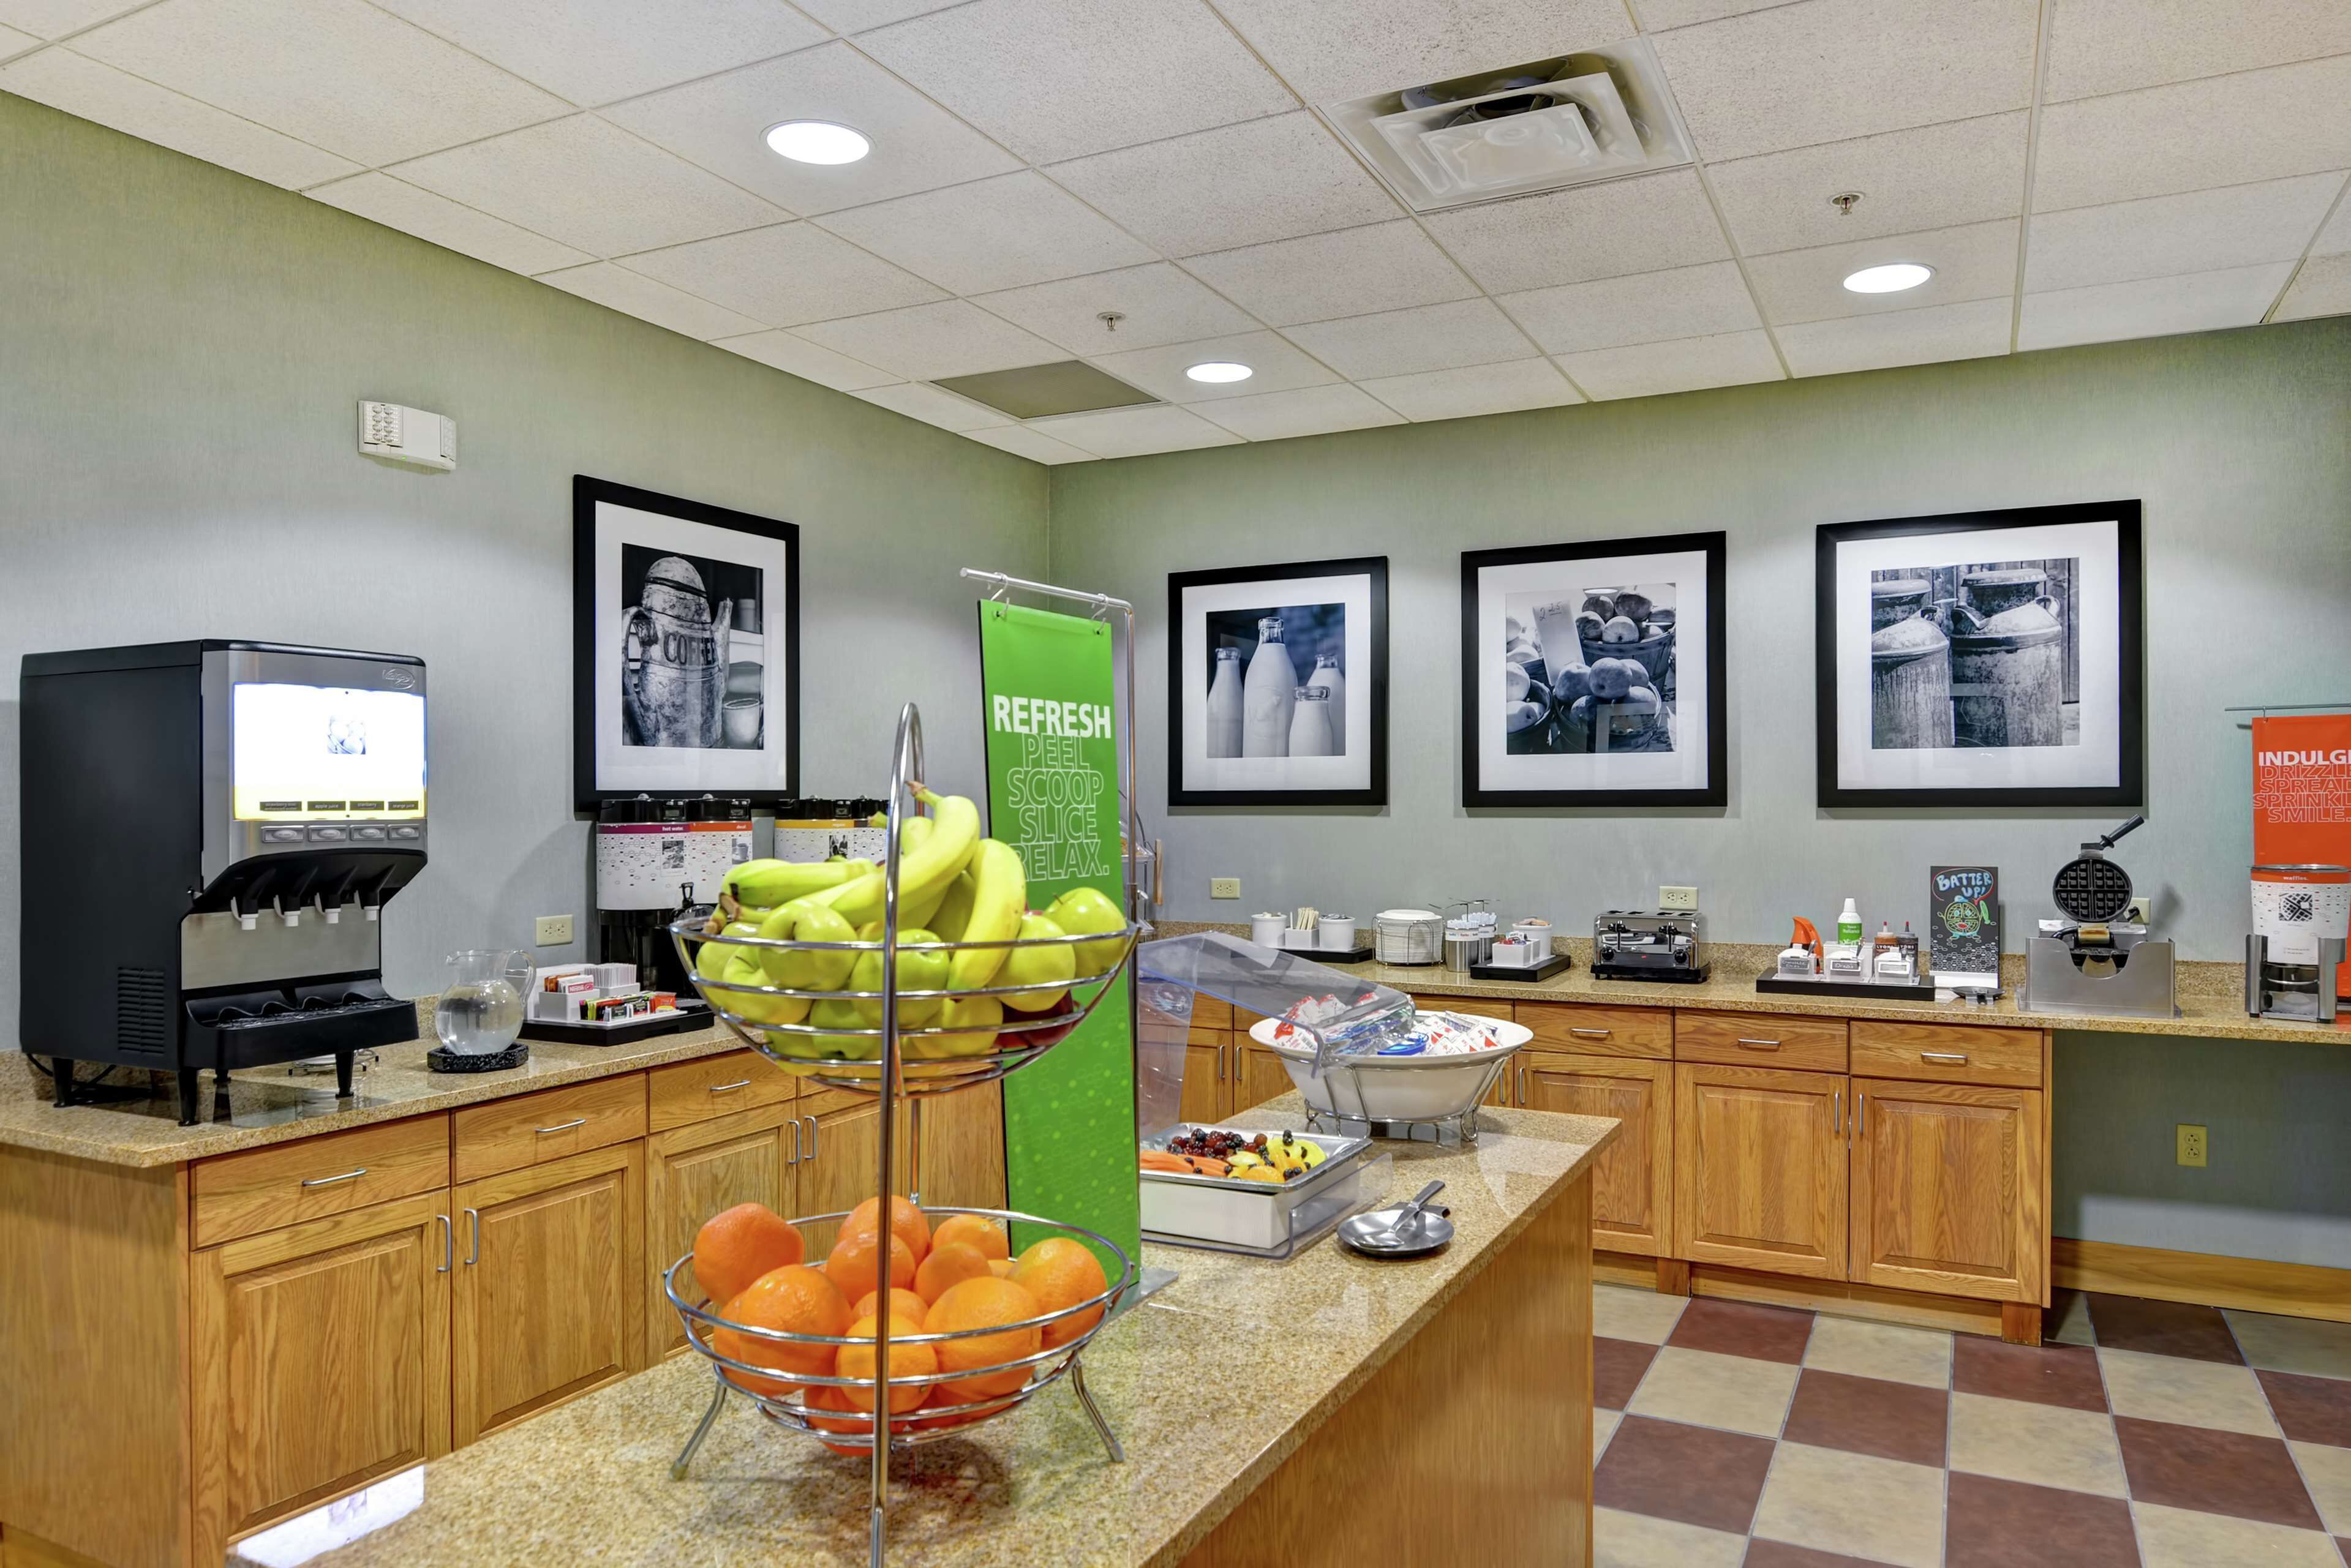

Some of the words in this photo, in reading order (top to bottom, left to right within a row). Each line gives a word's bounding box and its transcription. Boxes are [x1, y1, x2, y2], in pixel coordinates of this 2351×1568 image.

[993, 694, 1112, 739] REFRESH
[1021, 732, 1091, 771] PEEL
[2259, 749, 2351, 767] INDULG
[1007, 767, 1104, 808] SCOOP
[1018, 805, 1098, 846] SLICE
[2268, 806, 2351, 823] SMILE.
[1936, 871, 1992, 891] BATTER
[1962, 886, 1986, 898] UP!
